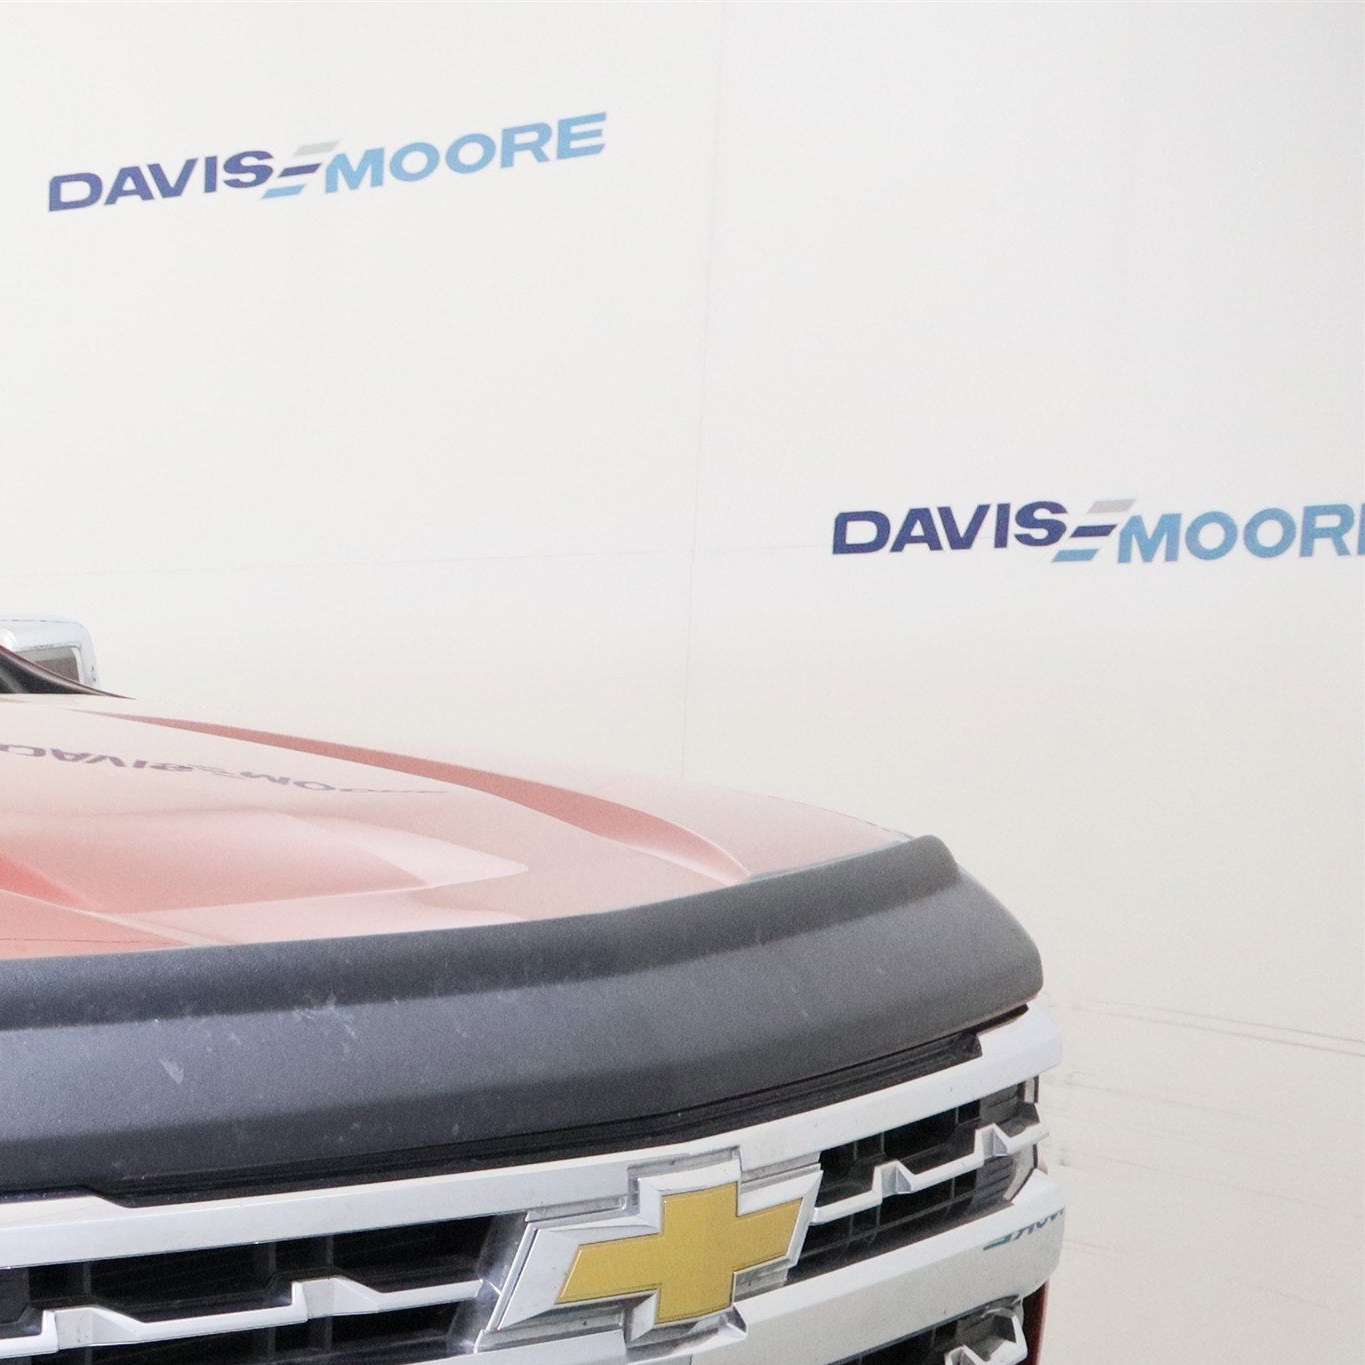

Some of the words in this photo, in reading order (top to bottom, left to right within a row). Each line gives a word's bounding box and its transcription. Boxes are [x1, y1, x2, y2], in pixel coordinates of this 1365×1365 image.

[48, 150, 272, 212] DAVIS
[325, 111, 608, 193] MOORE
[833, 501, 1068, 555] DAVIS
[1117, 501, 1365, 564] MOOR
